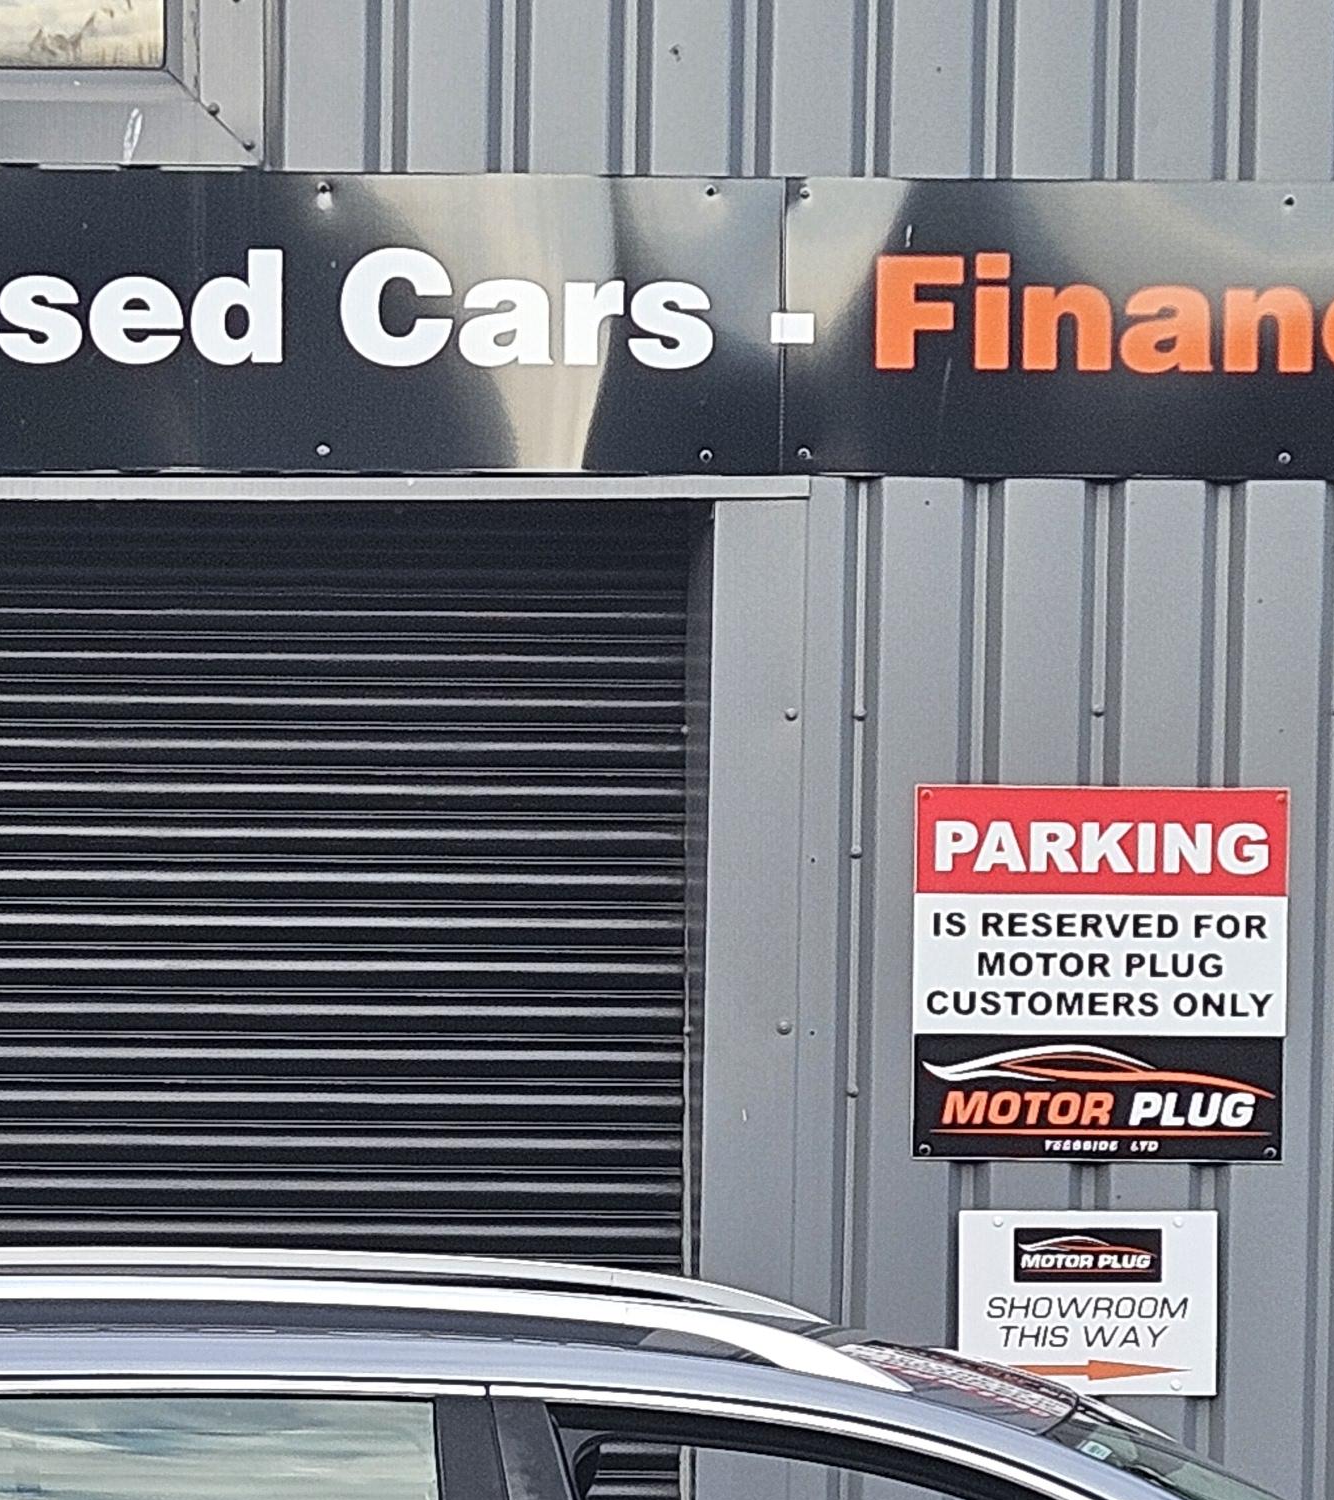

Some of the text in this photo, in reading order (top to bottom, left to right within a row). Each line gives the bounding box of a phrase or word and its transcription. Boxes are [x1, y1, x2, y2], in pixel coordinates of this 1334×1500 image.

[341, 248, 712, 368] Cars
[771, 313, 814, 343] -
[935, 821, 1268, 874] PARKING
[934, 913, 1265, 938] IS RESERVED FOR
[979, 952, 1222, 977] MOTOR PLUG
[927, 991, 1271, 1017] CUSTOMERS ONLY
[943, 1092, 1255, 1126] MOTOR PLUG
[1131, 1141, 1158, 1151] LTD
[1021, 1254, 1150, 1268] MOTOR PLUG
[987, 1297, 1188, 1318] SHOWROOM
[1000, 1326, 1167, 1347] THIS WAY
